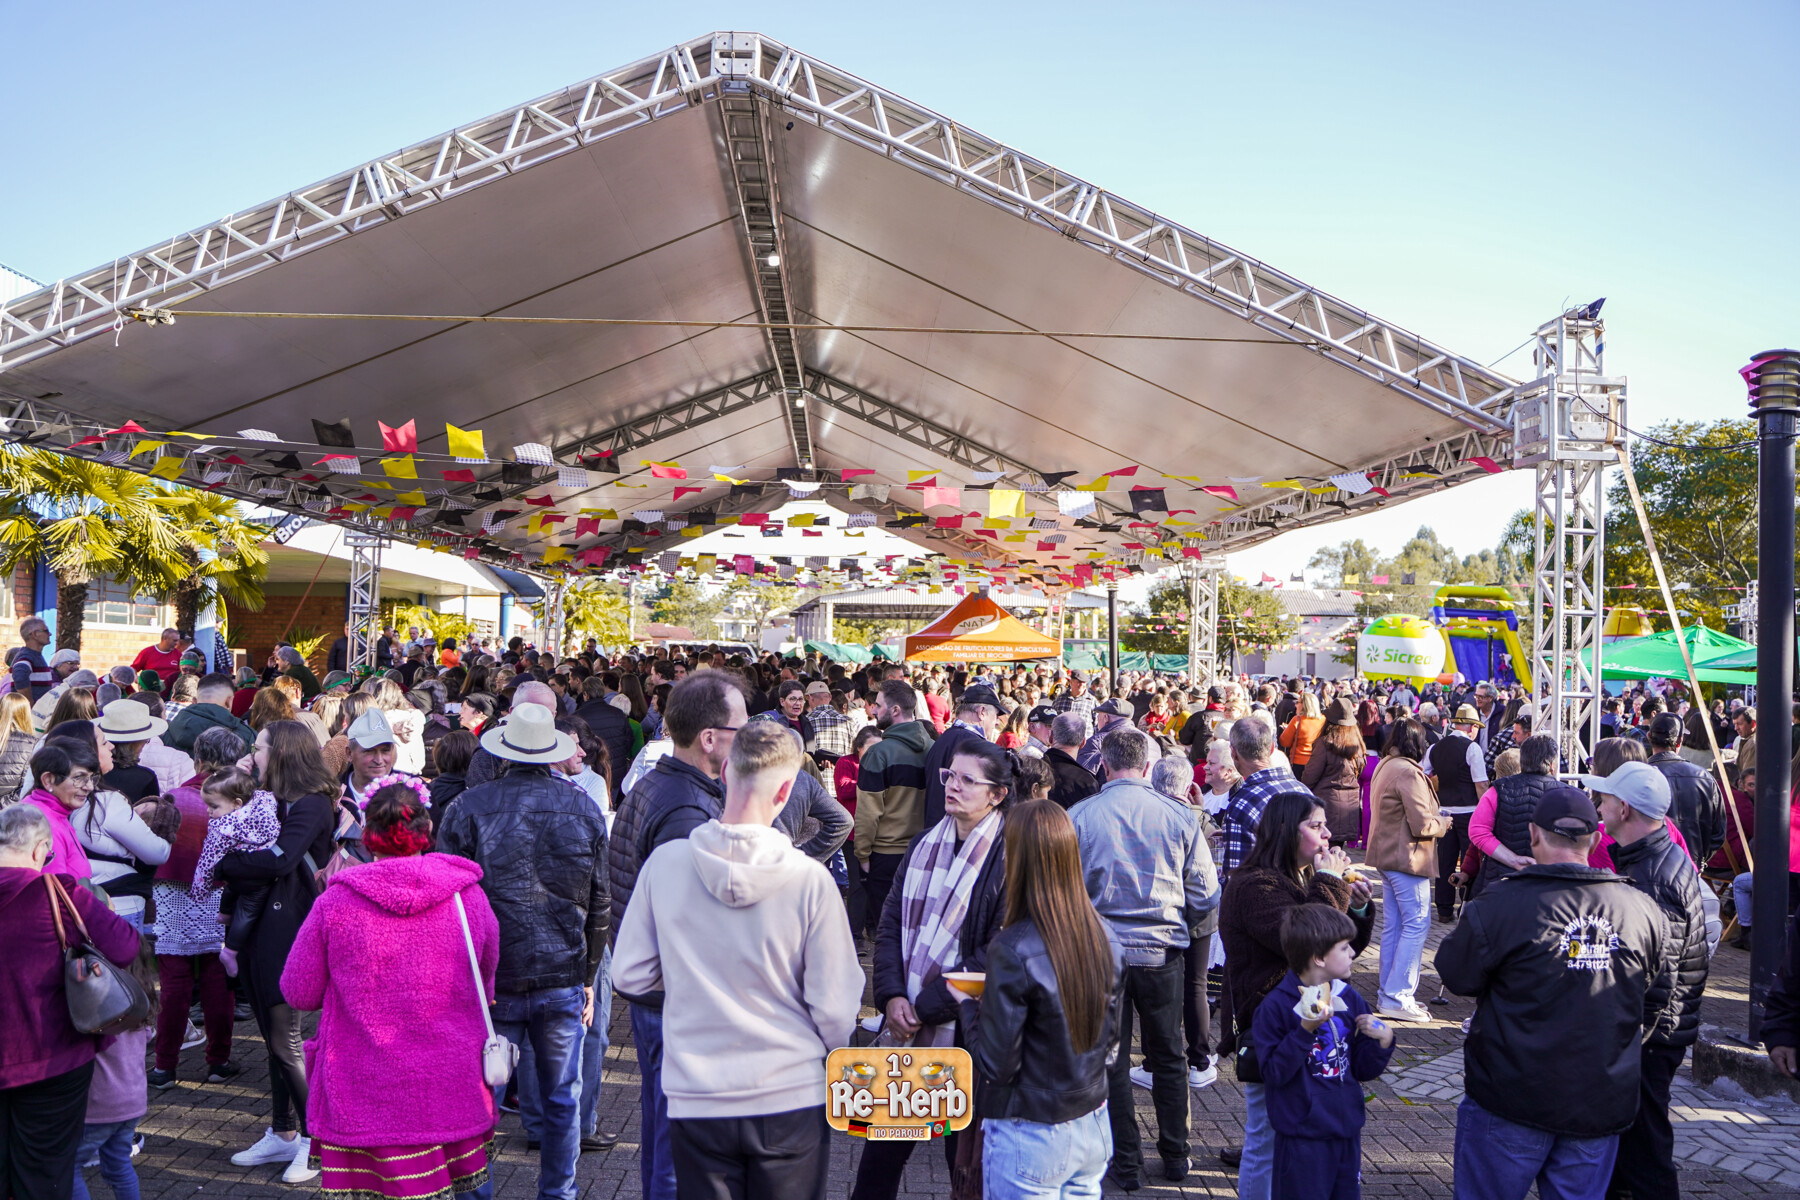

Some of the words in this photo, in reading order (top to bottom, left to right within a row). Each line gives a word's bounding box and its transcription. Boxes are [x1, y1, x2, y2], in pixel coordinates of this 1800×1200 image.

[915, 644, 954, 652] ASSOCIAÇÃO
[962, 645, 1005, 653] FRUTICULTORES
[1564, 916, 1587, 935] NOVA
[1588, 914, 1612, 936] SANTA
[1608, 932, 1619, 950] RITA
